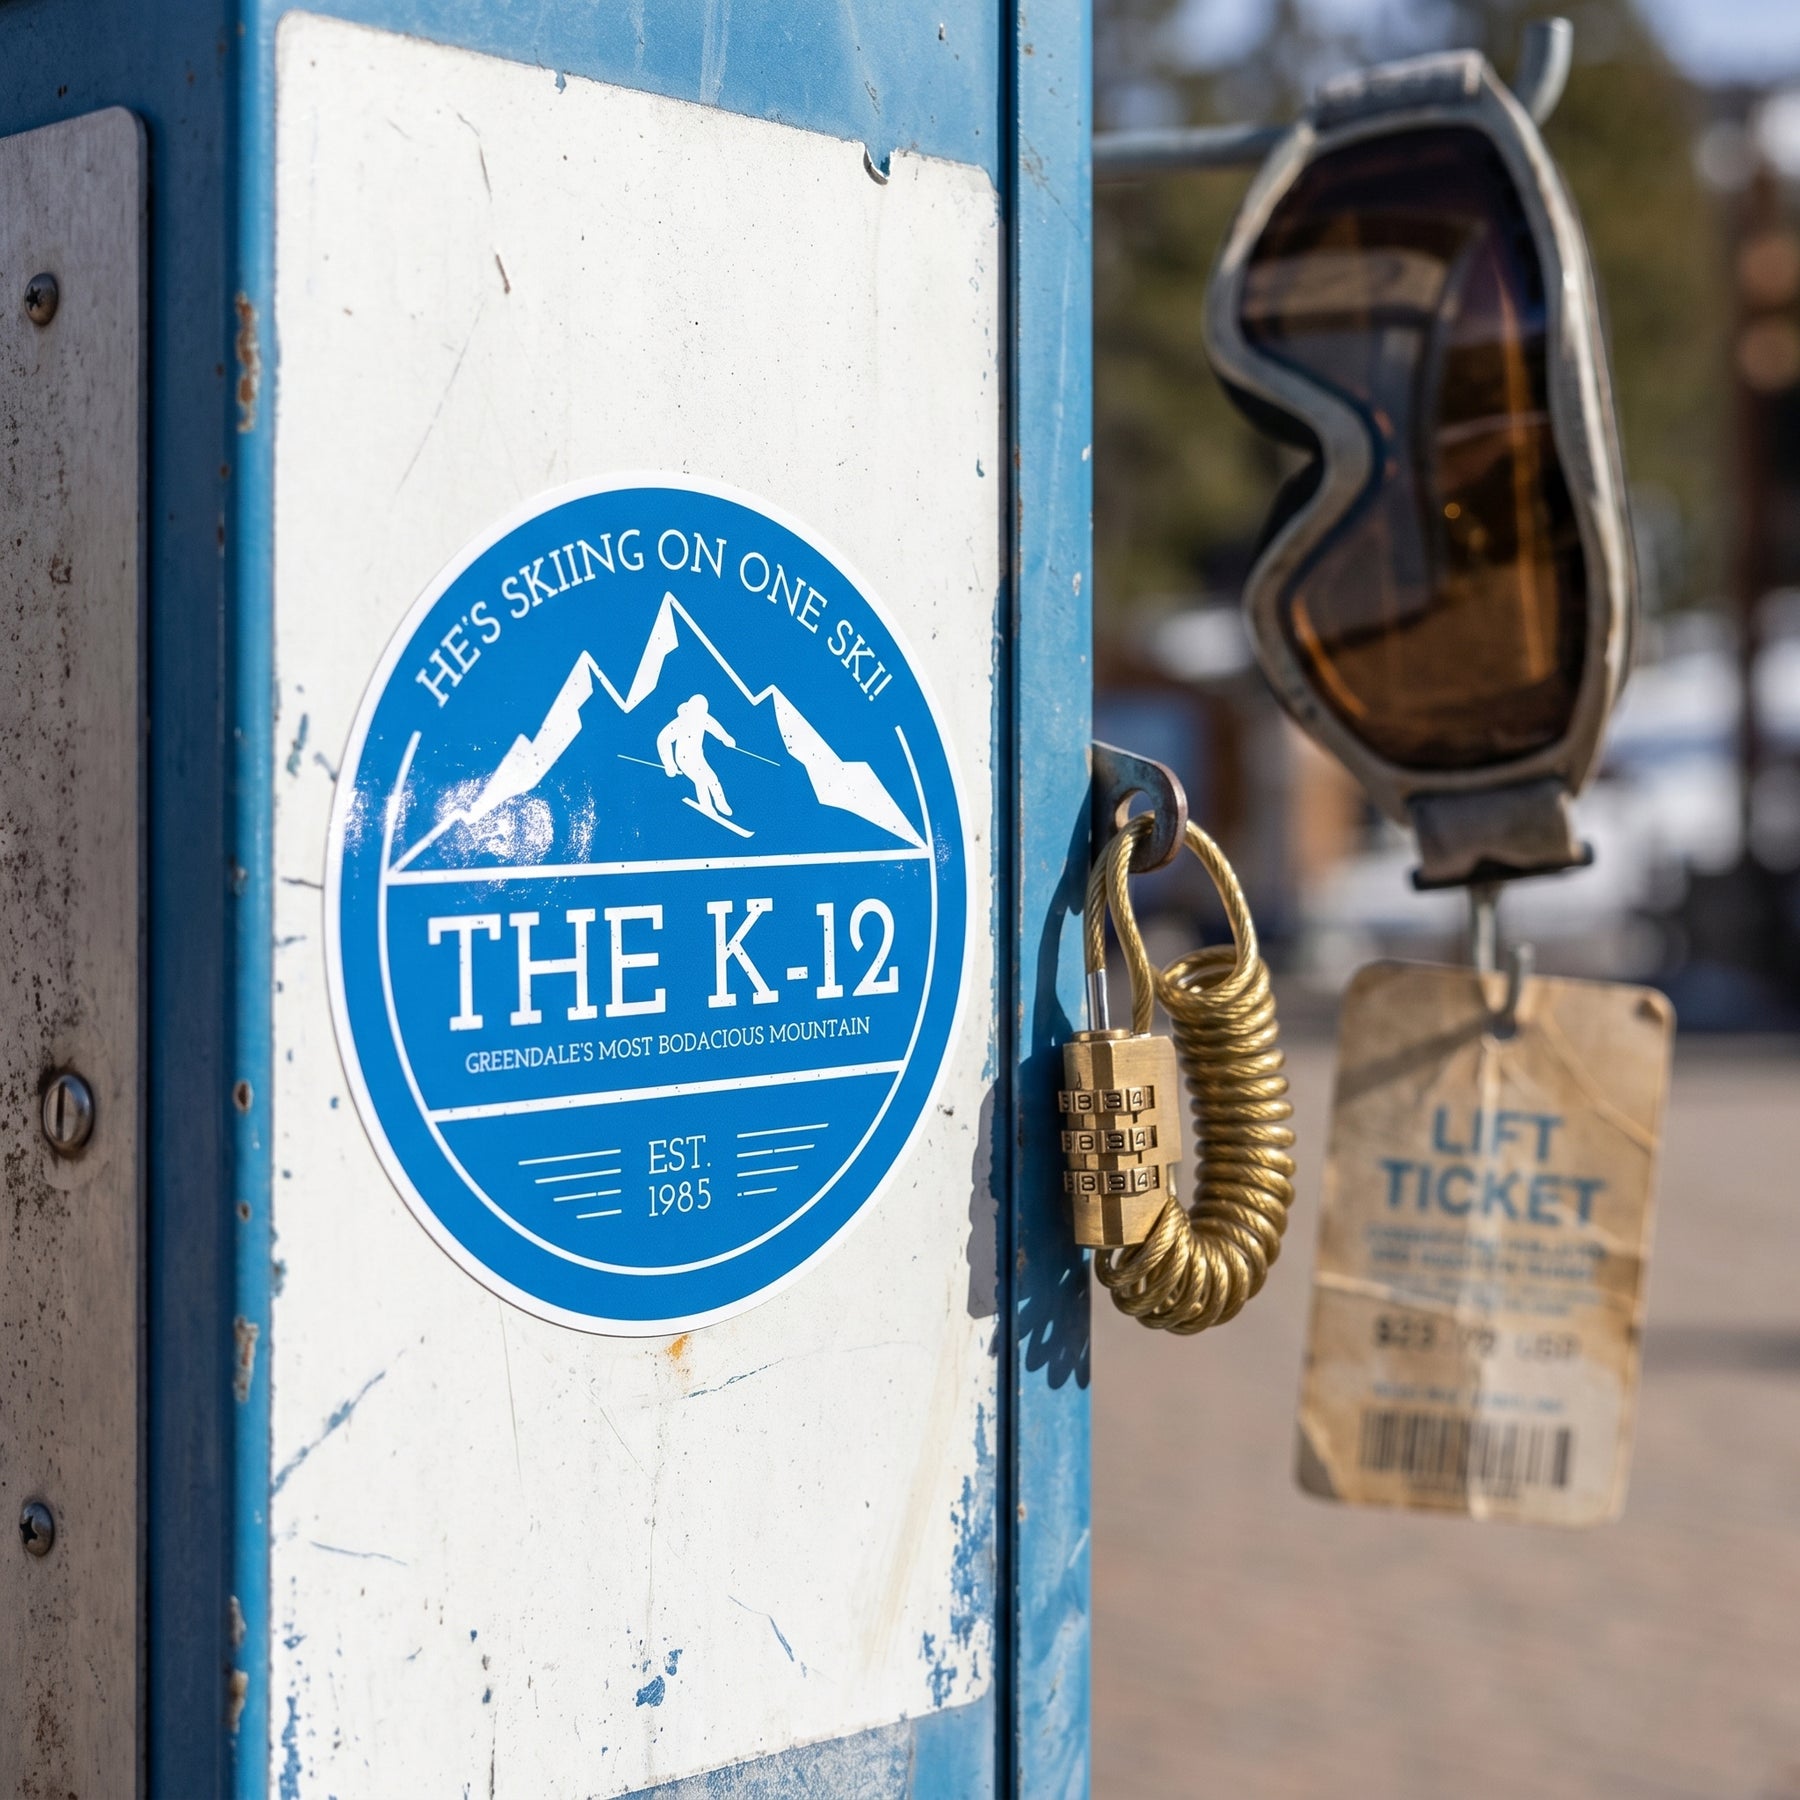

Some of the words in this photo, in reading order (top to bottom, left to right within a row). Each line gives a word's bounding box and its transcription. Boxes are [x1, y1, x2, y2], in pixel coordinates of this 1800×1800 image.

[416, 602, 501, 707] HE'S
[502, 530, 645, 618] SKIING
[658, 529, 726, 578] ON
[740, 552, 827, 633] ONE
[828, 620, 893, 701] SKI!
[428, 905, 665, 1030] THE
[707, 898, 898, 1008] K-12
[466, 1043, 593, 1073] GREENDALE'S
[599, 1037, 652, 1059] MOST
[659, 1026, 764, 1054] BODACIOUS
[770, 1017, 869, 1042] MOUNTAIN
[649, 1135, 710, 1174] EST.
[1432, 1106, 1565, 1163] LIFT
[649, 1178, 710, 1216] 1985
[1379, 1156, 1608, 1227] TICKET
